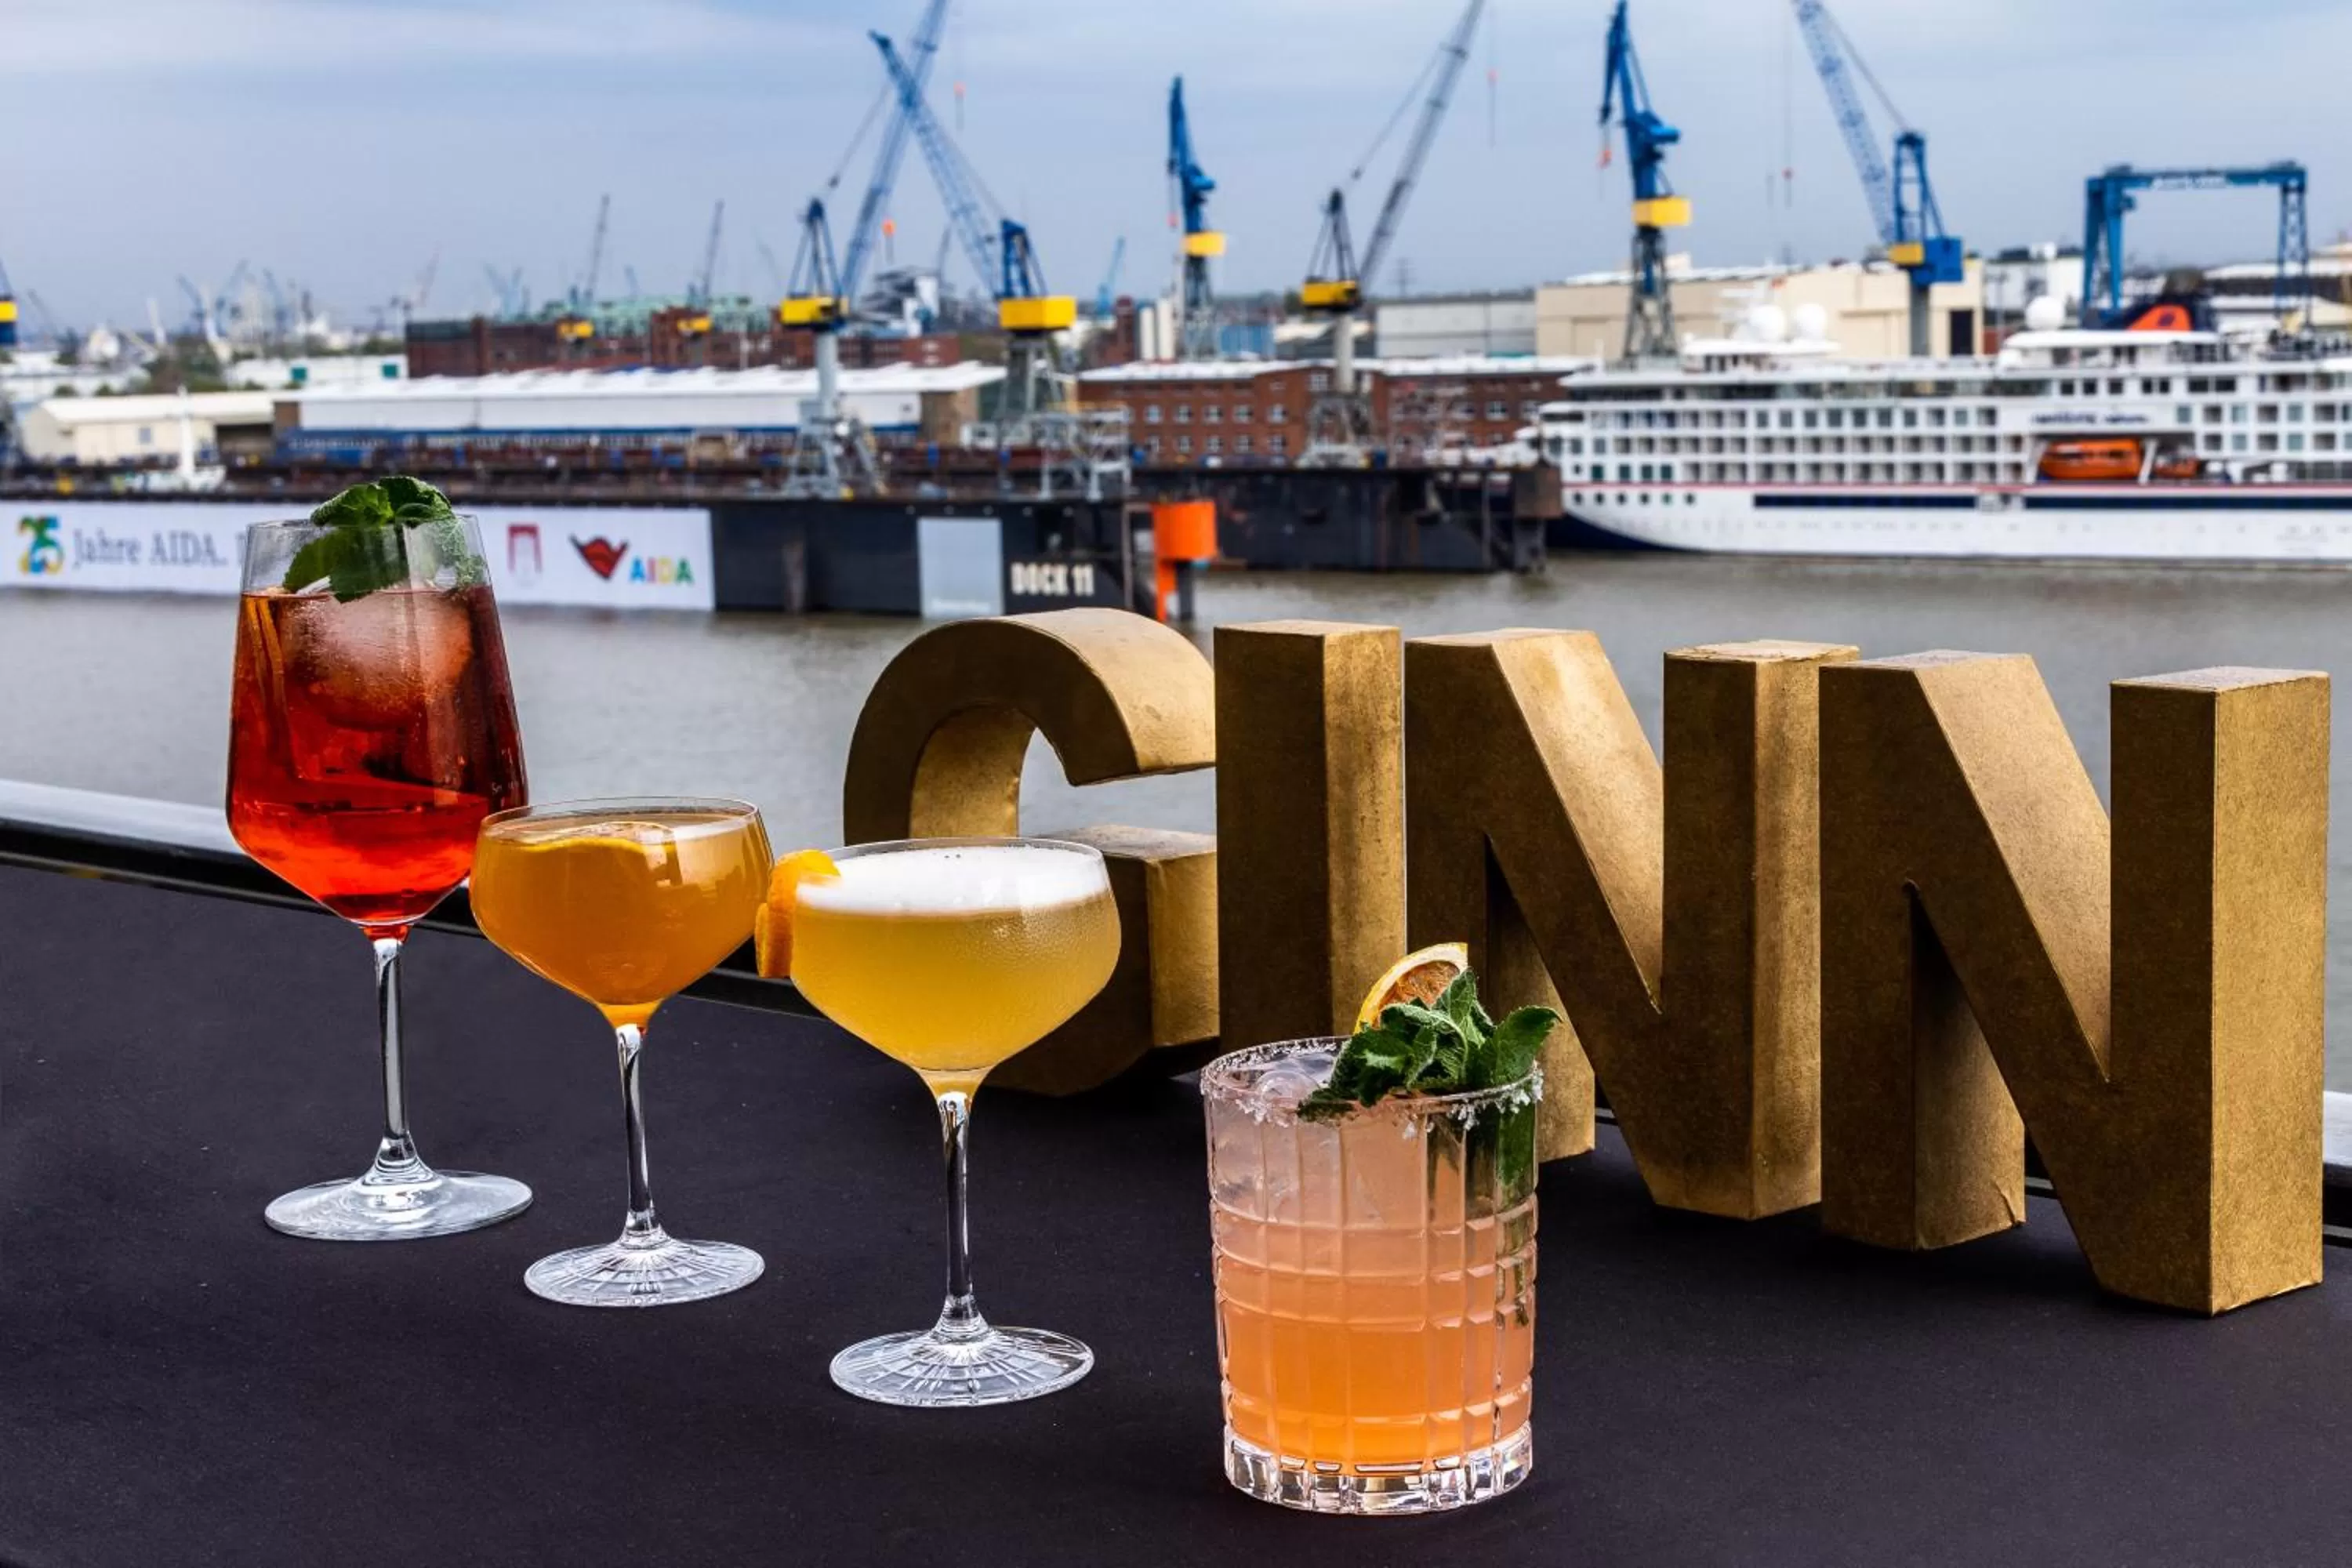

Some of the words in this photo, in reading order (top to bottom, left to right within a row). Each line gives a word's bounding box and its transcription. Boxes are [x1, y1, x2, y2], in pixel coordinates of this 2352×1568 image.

[72, 527, 142, 569] Jahre
[630, 556, 694, 583] AIDA
[1011, 561, 1069, 596] DOCK
[1072, 563, 1094, 596] 11
